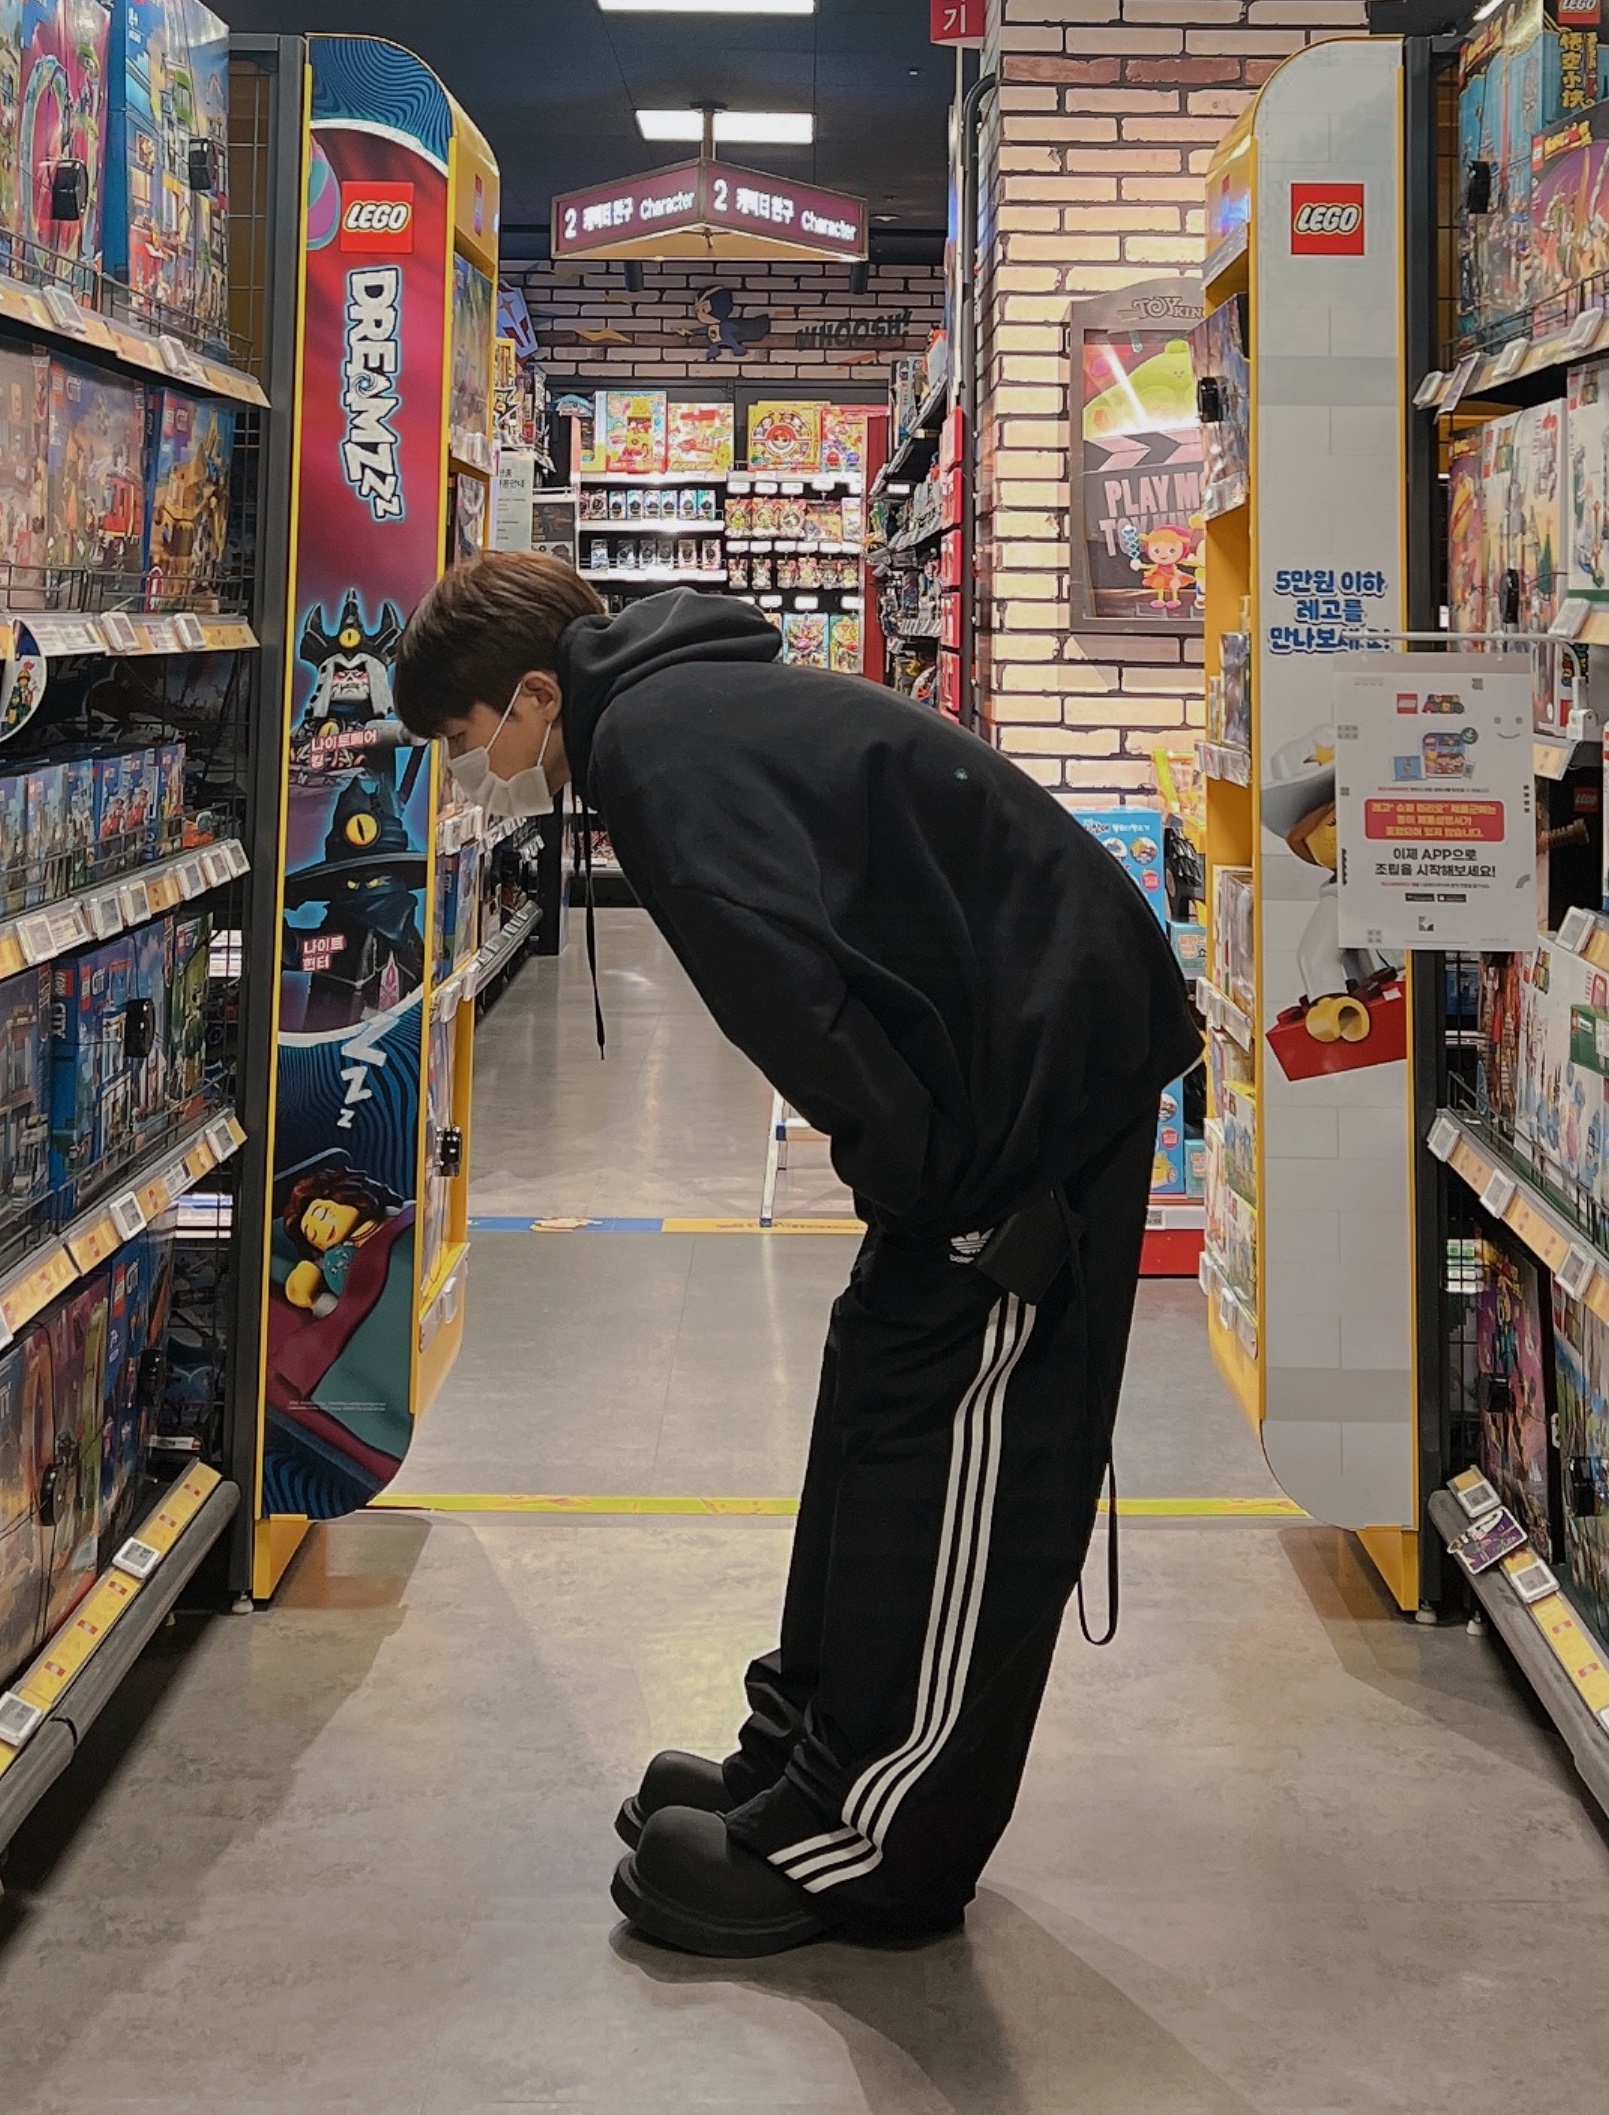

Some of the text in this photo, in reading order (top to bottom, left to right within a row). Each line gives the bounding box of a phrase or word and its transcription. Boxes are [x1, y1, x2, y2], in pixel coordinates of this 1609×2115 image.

[346, 203, 408, 230] LEGO
[563, 207, 578, 239] 2
[639, 190, 696, 221] Character
[714, 178, 728, 212] 2
[800, 210, 858, 242] Character
[1296, 205, 1359, 232] LEGO
[1132, 296, 1205, 319] TOY KIN
[1104, 471, 1205, 518] PLAY M
[1275, 570, 1386, 593] 5만원 이하
[1296, 598, 1364, 622] 레고를
[1393, 848, 1477, 861] 이제 APP으로
[1375, 863, 1496, 878] 조립을 시작해보세요!
[303, 935, 345, 954] 나이트
